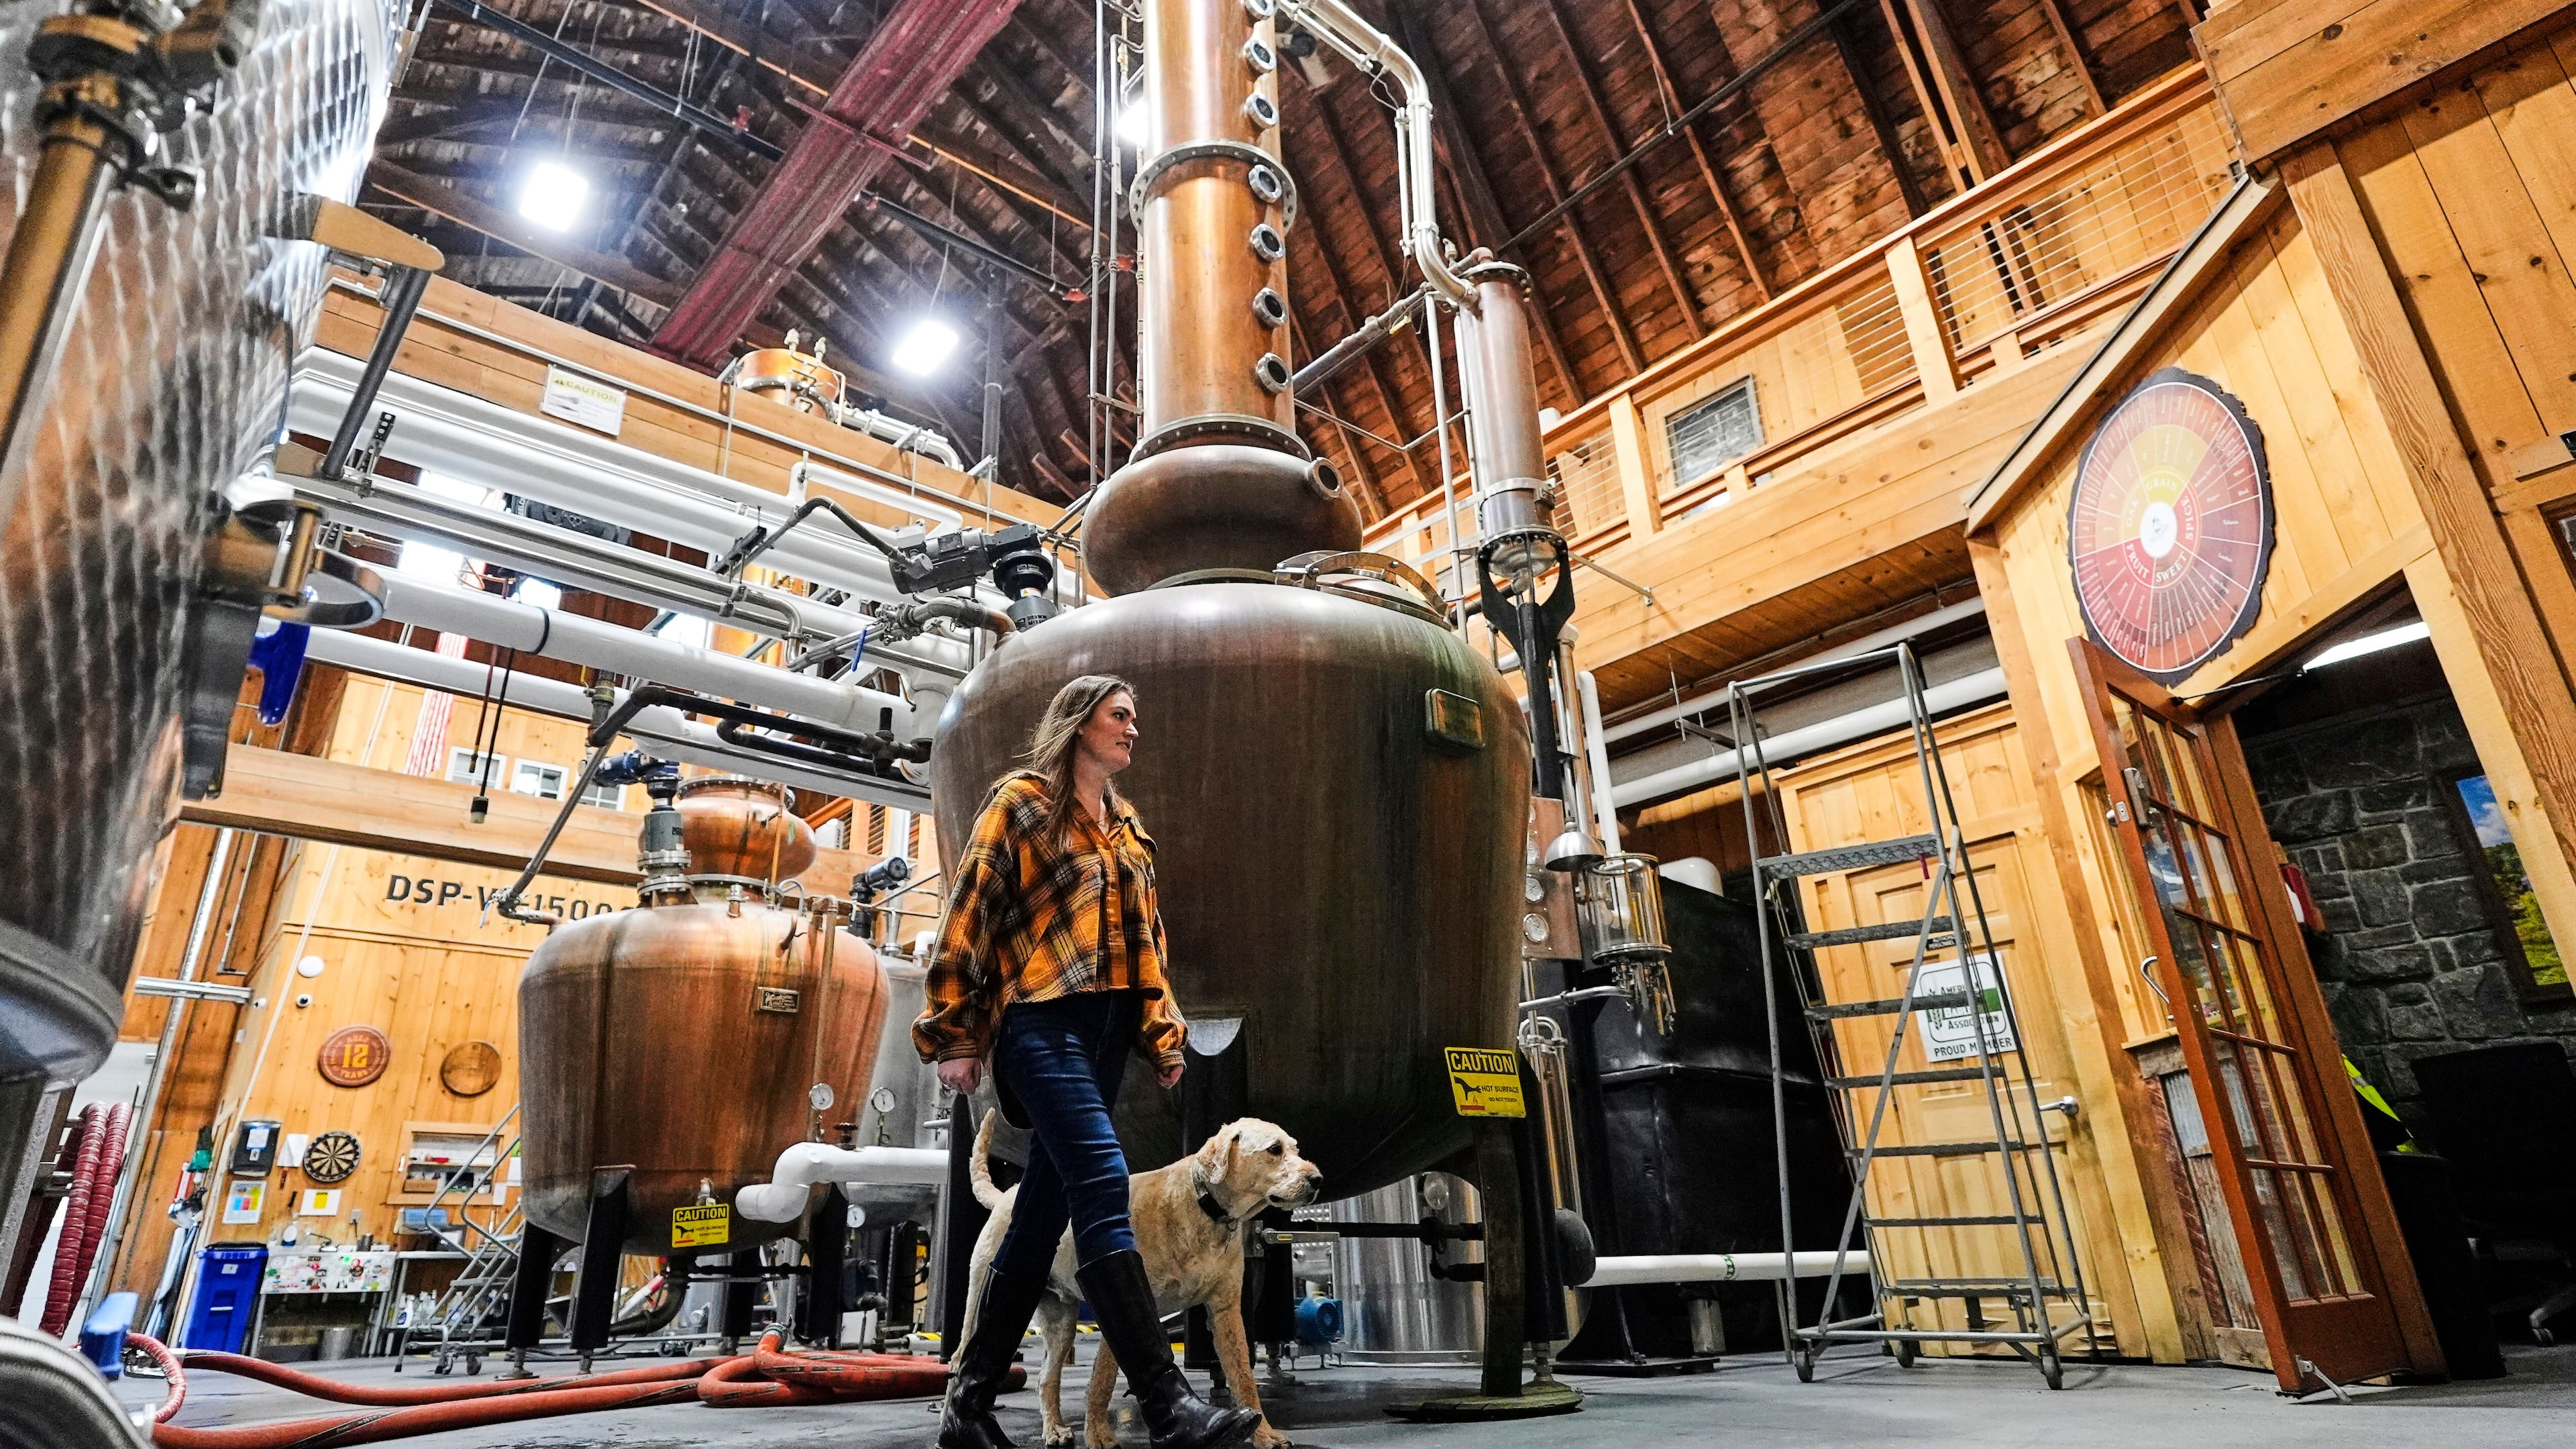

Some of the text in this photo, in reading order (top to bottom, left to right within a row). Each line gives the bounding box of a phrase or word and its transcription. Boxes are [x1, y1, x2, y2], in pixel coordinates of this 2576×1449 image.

[566, 380, 618, 403] CAUTION
[2146, 478, 2178, 492] GRAIN
[2126, 498, 2140, 527] OAK
[2180, 496, 2194, 541] SPICE
[2126, 543, 2150, 580] FRUIT
[2155, 551, 2188, 583] SWEET
[341, 1043, 370, 1069] 12
[1934, 1044, 1966, 1057] PROUD
[1450, 1053, 1514, 1073] CAUTION
[1495, 1085, 1519, 1093] SURFACE
[676, 1208, 726, 1222] CAUTION
